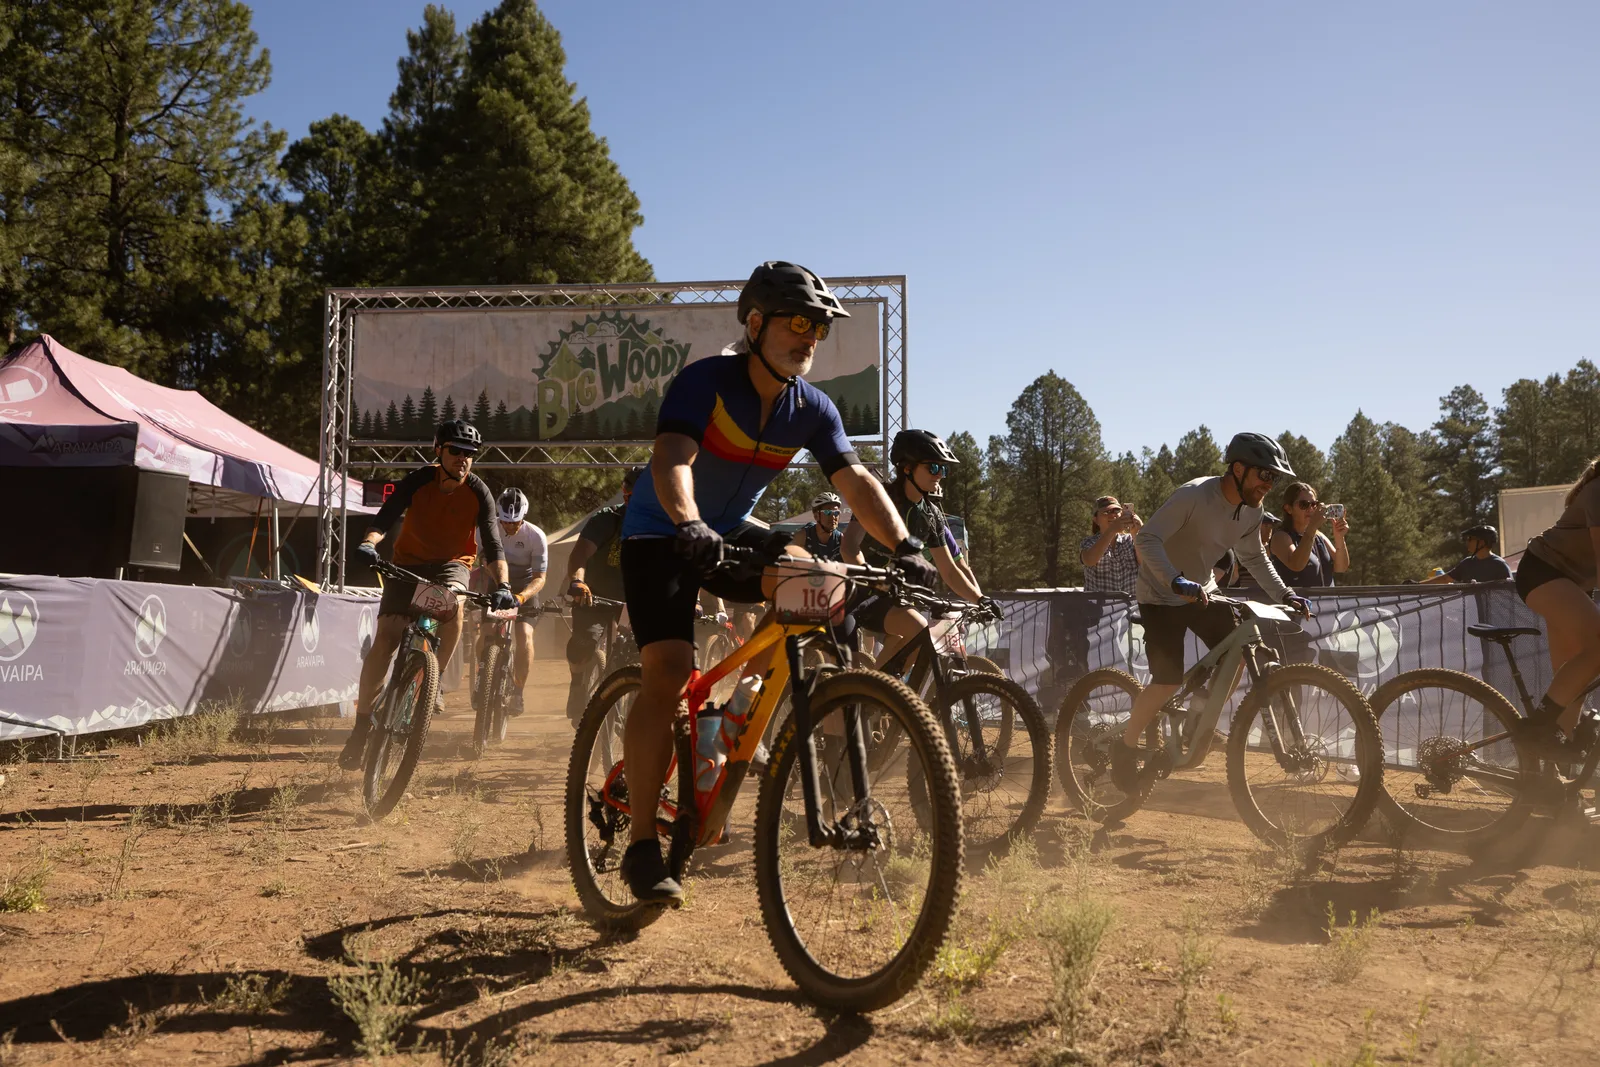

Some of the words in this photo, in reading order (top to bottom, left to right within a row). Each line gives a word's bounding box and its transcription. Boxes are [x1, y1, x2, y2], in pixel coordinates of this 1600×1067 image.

[537, 368, 597, 440] BIG
[597, 339, 692, 399] WOODY
[52, 441, 123, 454] ARAVAIPA
[424, 596, 443, 612] 132
[802, 588, 828, 608] 116
[124, 661, 166, 675] ARAVAIPA
[297, 655, 325, 668] ARAVAIPA
